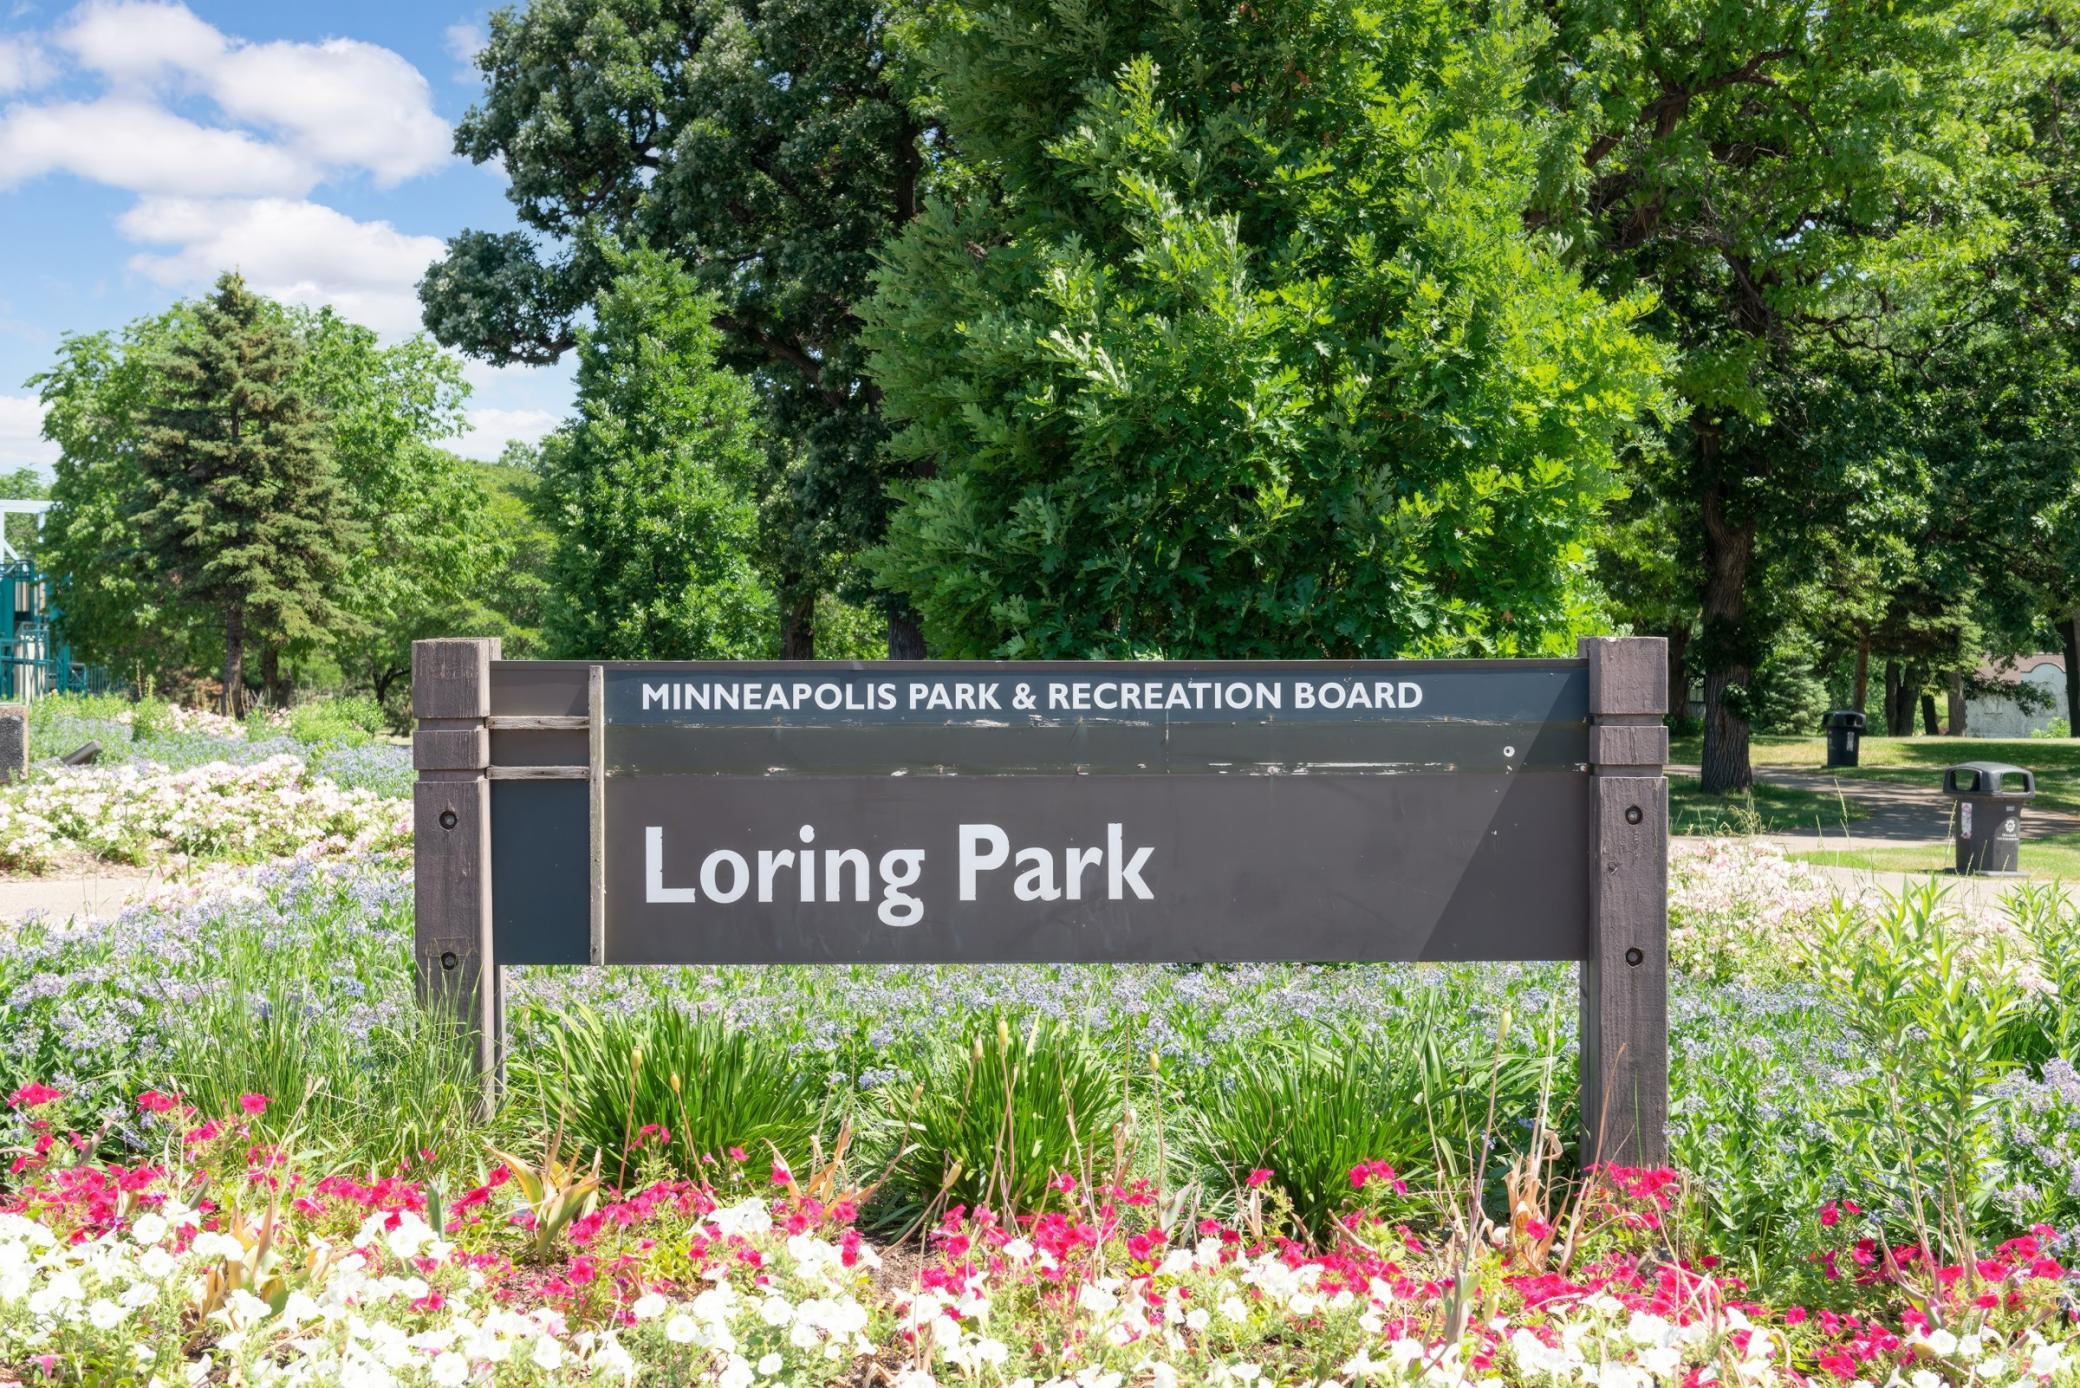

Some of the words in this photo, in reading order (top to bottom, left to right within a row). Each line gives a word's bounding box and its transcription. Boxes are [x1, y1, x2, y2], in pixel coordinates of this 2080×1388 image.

[642, 682, 897, 710] MINNEAPOLIS
[909, 682, 1002, 710] PARK
[1012, 682, 1037, 710] &
[1048, 682, 1282, 710] RECREATION
[1294, 682, 1424, 709] BOARD
[645, 824, 926, 927] Loring
[958, 822, 1155, 902] Park
